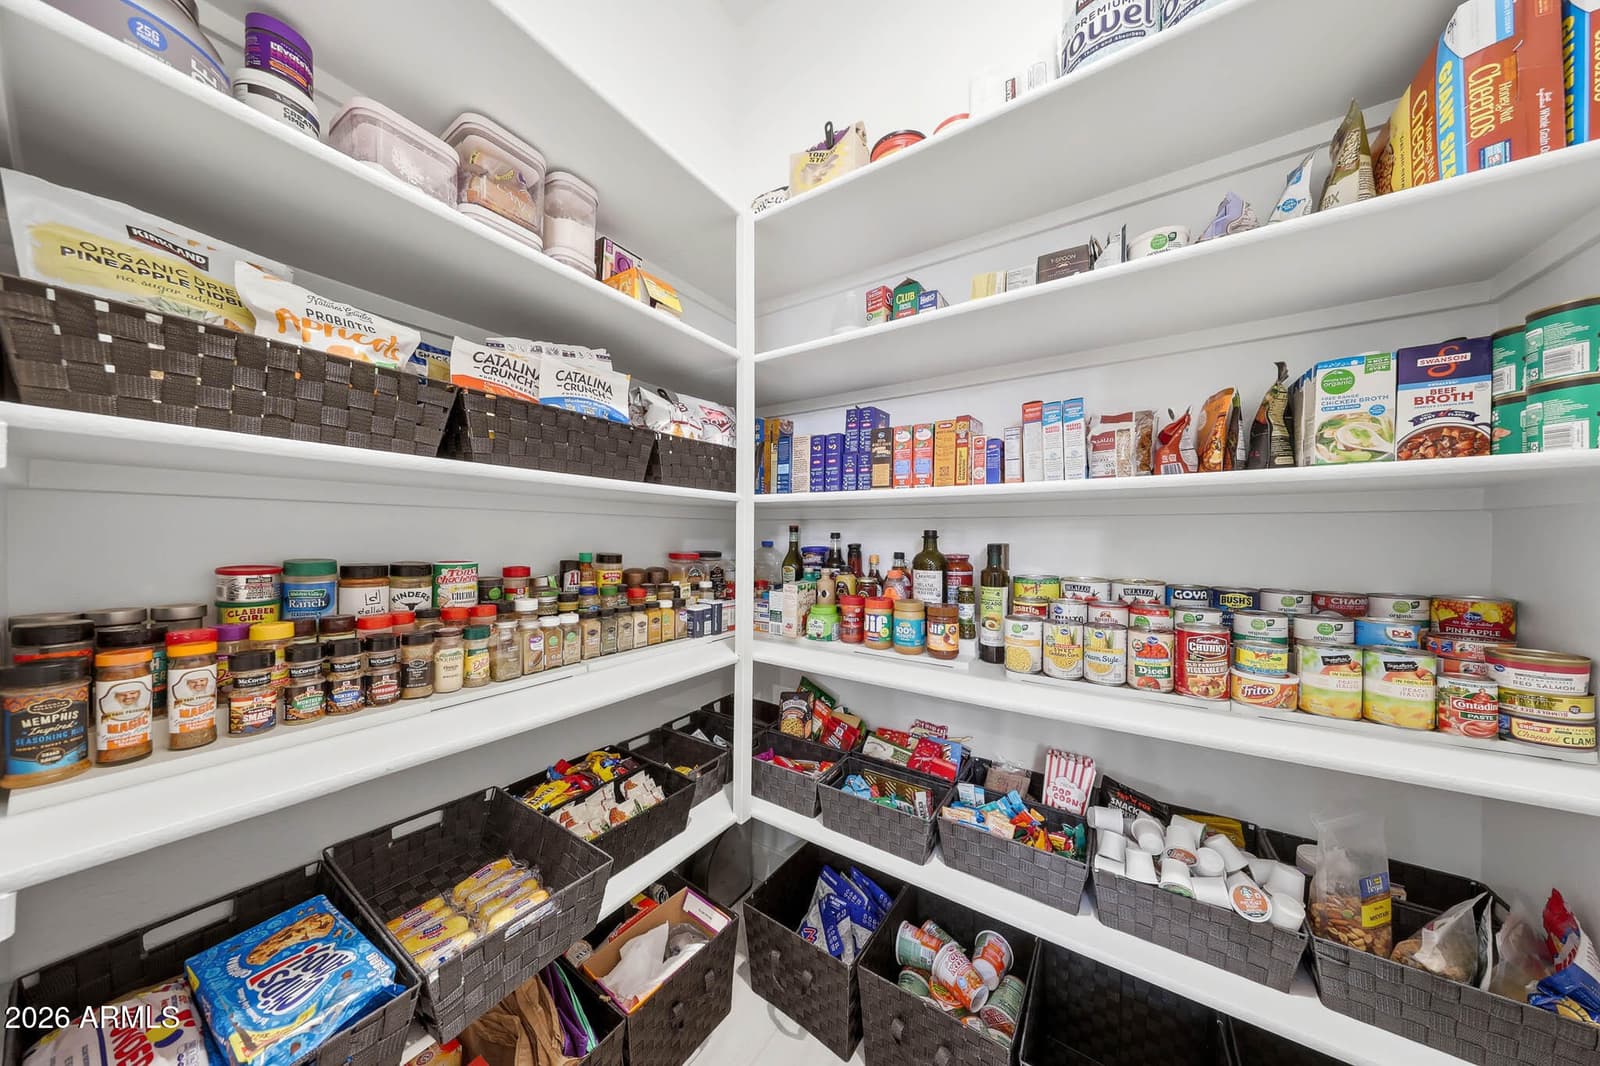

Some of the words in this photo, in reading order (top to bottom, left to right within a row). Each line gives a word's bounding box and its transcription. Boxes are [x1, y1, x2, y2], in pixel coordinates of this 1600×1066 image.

[1438, 61, 1455, 134] GIANT
[1468, 63, 1502, 139] Cheerios
[1411, 89, 1428, 187] Cheerio
[1441, 132, 1457, 179] SIZE
[132, 227, 207, 265] KIRKLAND
[60, 244, 190, 289] PINEAPPLE
[196, 285, 243, 309] TIDBI
[79, 240, 189, 279] ORGANIC
[193, 275, 240, 299] DRIE
[141, 278, 183, 297] sugar
[186, 292, 225, 311] added
[895, 291, 915, 305] CLUB
[305, 307, 377, 334] PROBIOTIC
[1419, 354, 1468, 366] SWANSON
[481, 365, 534, 390] CRUNCH
[555, 369, 614, 396] CATALINA
[563, 382, 606, 400] CRUNCH
[1430, 386, 1457, 395] BEEF
[1321, 398, 1357, 406] CHICKEN
[1359, 394, 1389, 403] BROTH
[1413, 391, 1474, 406] BROTH
[1174, 590, 1208, 600] GOYA
[1221, 595, 1254, 606] BUSH'S
[289, 598, 327, 608] Ranch
[227, 607, 275, 618] CLABBER
[238, 615, 265, 623] GIRL
[865, 613, 888, 633] Jif
[929, 624, 945, 635] Jif
[1391, 629, 1413, 639] Dole
[1445, 626, 1501, 637] PINEAPPLE
[1189, 641, 1226, 653] CHUNKY
[1138, 665, 1169, 675] Diced
[1536, 681, 1576, 692] SALMON
[1453, 700, 1498, 711] Contadin
[21, 710, 80, 728] MEMPHIS
[1467, 713, 1494, 721] PASTE
[28, 720, 74, 736] Inspired
[15, 731, 68, 746] SEASONING
[1517, 729, 1560, 744] Chopped
[1052, 785, 1072, 796] POP
[1053, 792, 1079, 807] CORN
[1110, 797, 1140, 815] SNACK
